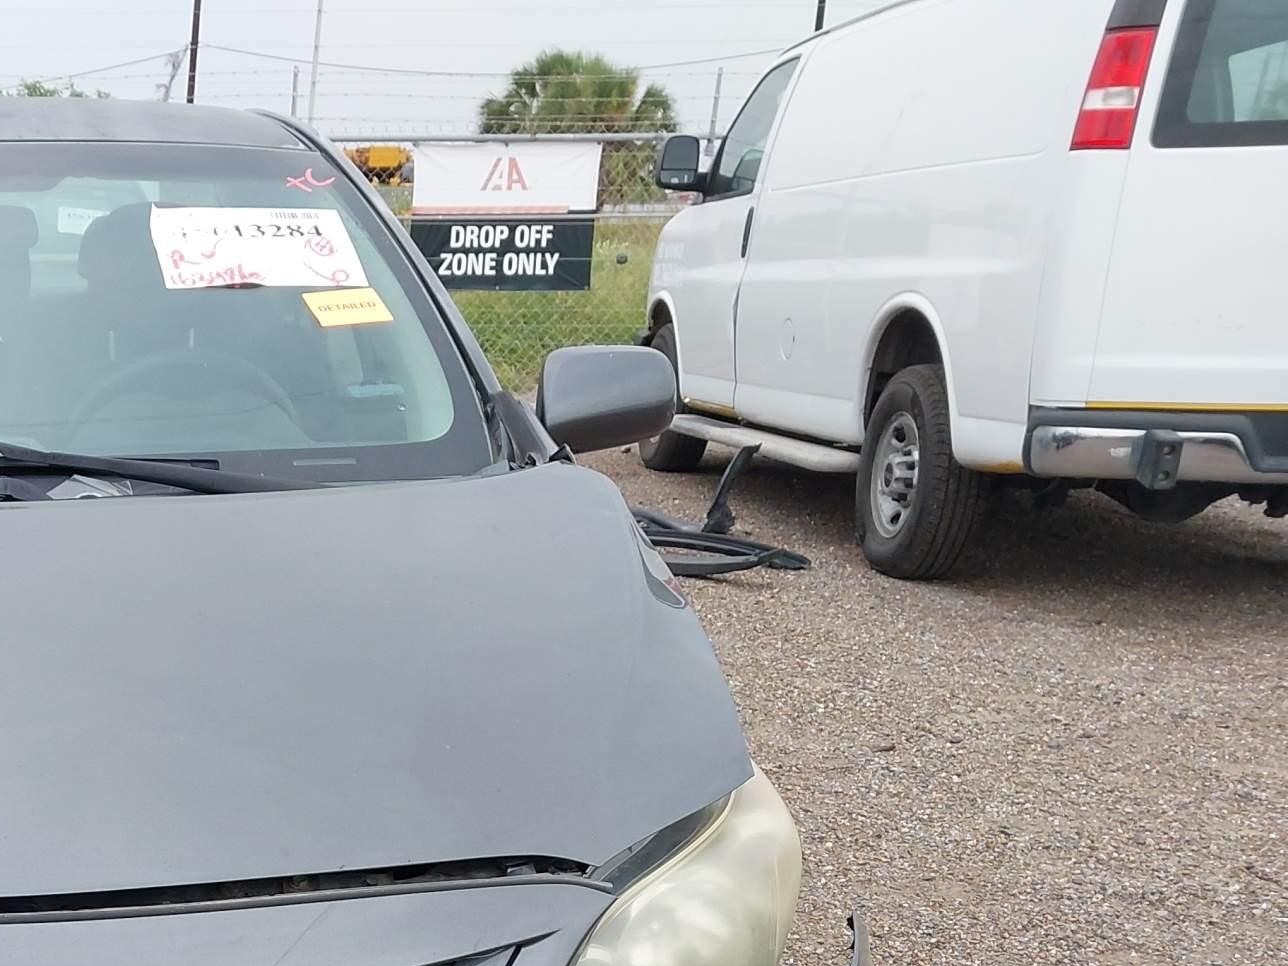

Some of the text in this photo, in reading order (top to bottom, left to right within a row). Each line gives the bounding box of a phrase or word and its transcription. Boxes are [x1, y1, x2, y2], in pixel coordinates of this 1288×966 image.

[449, 225, 554, 249] DROP OFF
[438, 252, 560, 276] ZONE ONLY
[318, 301, 377, 312] DETAILED
